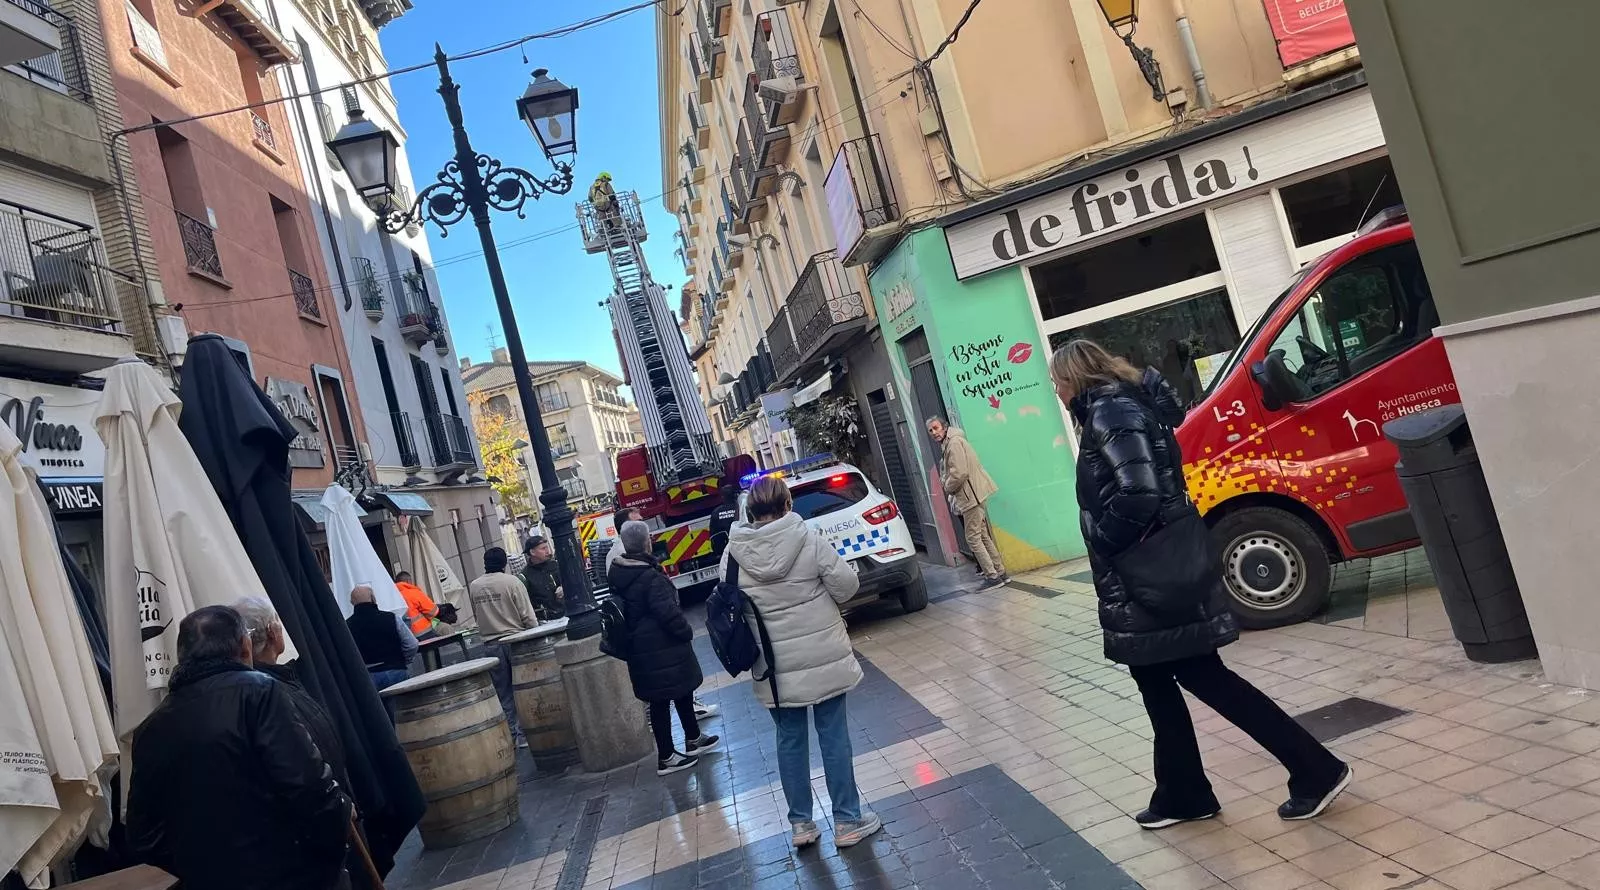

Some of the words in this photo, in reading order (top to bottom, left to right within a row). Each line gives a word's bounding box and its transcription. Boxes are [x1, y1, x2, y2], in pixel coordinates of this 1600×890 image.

[1298, 0, 1344, 19] BELLEZZ
[992, 208, 1064, 261] de
[973, 350, 1001, 377] esta
[962, 371, 1013, 398] esquina
[1378, 382, 1456, 411] Ayuntamiento
[1213, 400, 1246, 423] L-3
[1381, 411, 1396, 421] de
[1397, 398, 1441, 417] Huesca
[0, 396, 82, 453] Vinea
[40, 458, 84, 467] VINOTECA
[49, 485, 102, 509] VINEA
[824, 518, 861, 535] HUESCA
